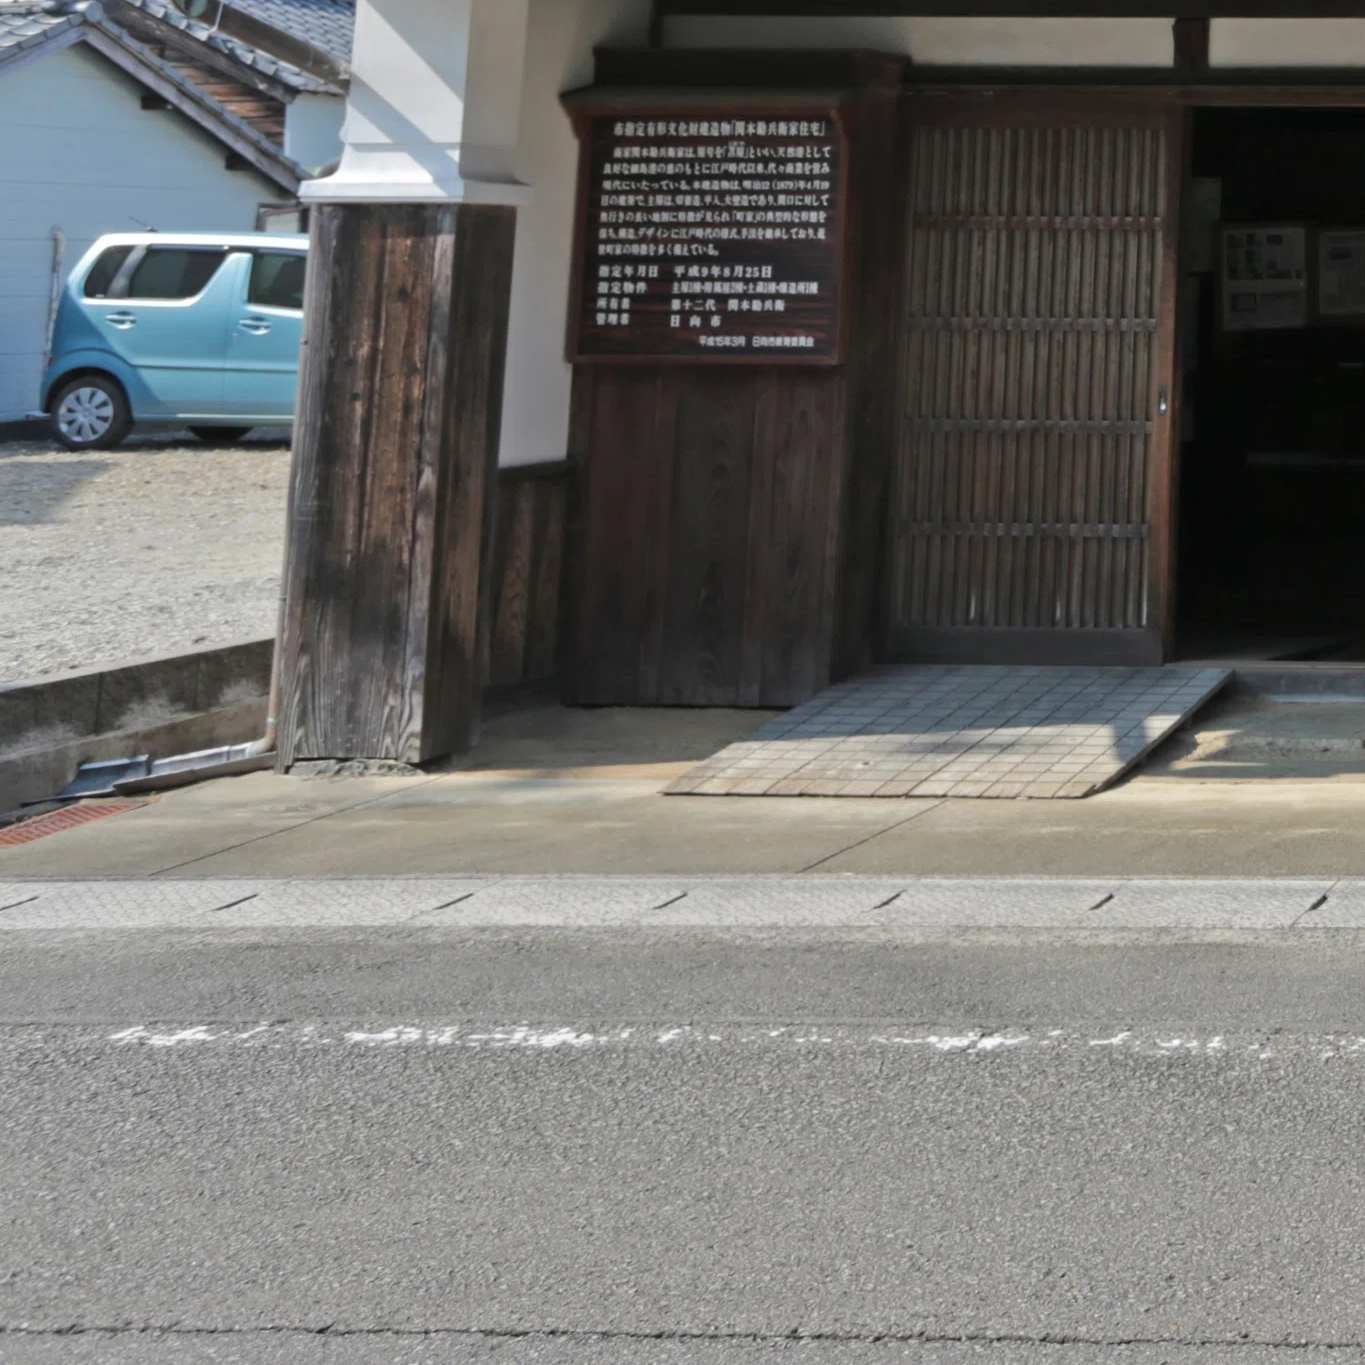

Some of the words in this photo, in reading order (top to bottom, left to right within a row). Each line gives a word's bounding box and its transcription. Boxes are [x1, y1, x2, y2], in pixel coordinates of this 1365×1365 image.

[599, 265, 658, 277] 指定年月日
[675, 265, 772, 278] 平成9年8月25日
[598, 282, 646, 294] 指定物件
[597, 298, 630, 309] 所有者
[671, 299, 716, 311] 第十二代
[596, 313, 629, 324] 管理者
